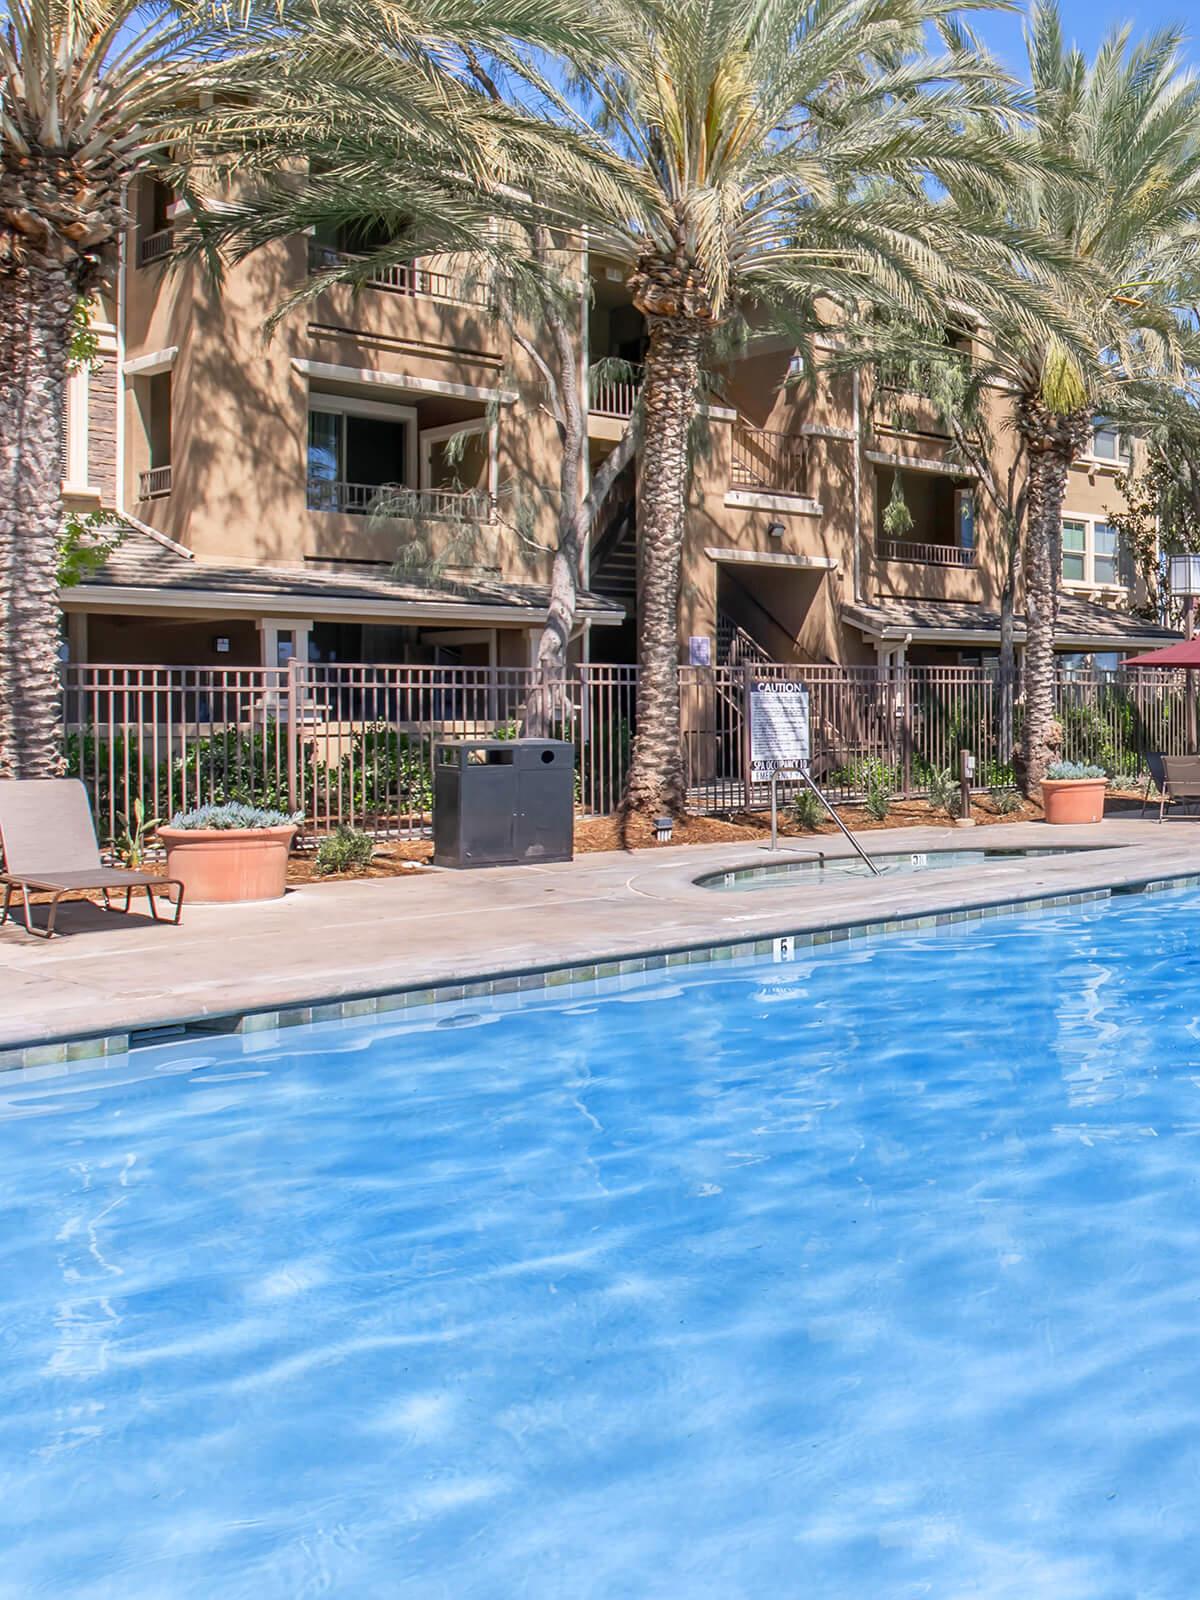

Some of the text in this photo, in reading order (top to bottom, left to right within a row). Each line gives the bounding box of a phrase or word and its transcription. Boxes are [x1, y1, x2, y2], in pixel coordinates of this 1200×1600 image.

[757, 683, 802, 692] CAUTION
[753, 761, 766, 770] SPA
[766, 760, 799, 769] OCCUPANCY
